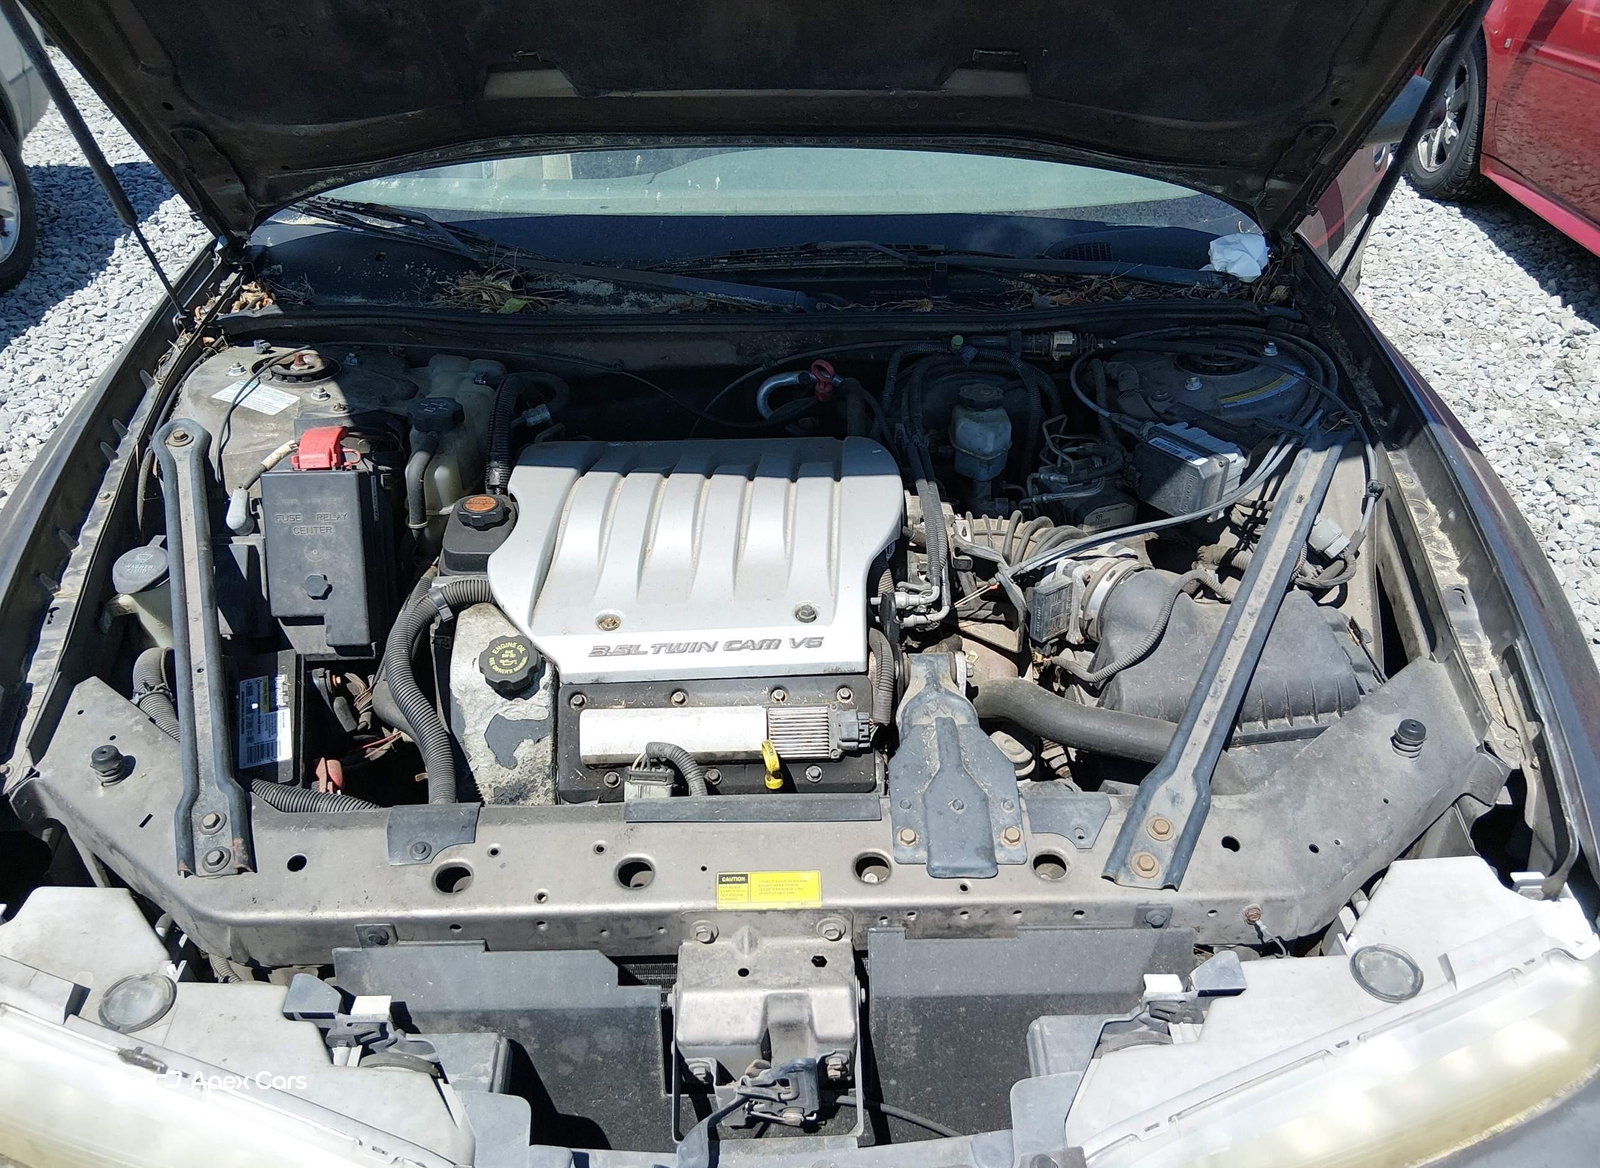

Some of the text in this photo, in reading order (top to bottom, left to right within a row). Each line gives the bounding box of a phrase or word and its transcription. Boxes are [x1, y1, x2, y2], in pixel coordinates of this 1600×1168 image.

[275, 512, 348, 523] FUSE RELAY
[293, 525, 333, 535] CENTER
[492, 642, 517, 654] ENGINE
[588, 636, 825, 657] 3.5L TWIN CAM V6
